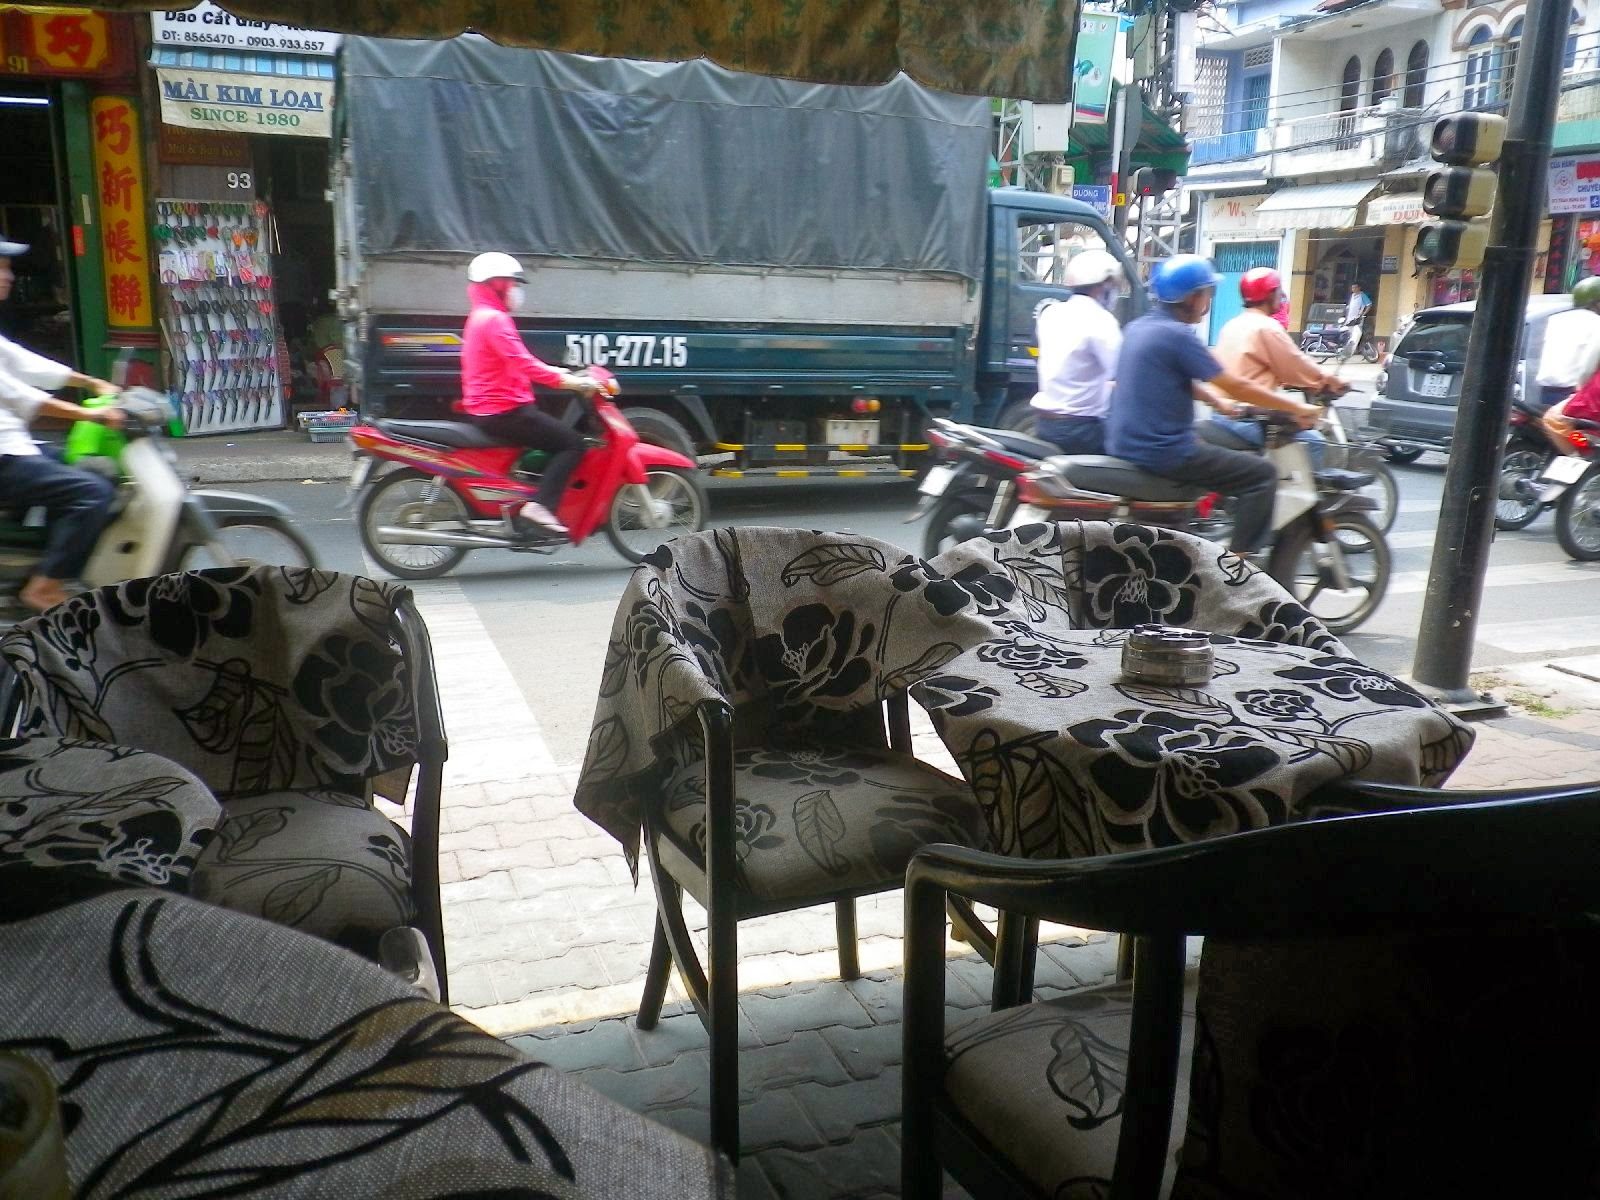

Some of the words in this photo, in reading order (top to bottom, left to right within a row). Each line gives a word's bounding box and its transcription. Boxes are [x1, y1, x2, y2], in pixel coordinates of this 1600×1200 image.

[164, 10, 197, 23] Dao
[161, 30, 181, 42] ĐT:
[184, 31, 235, 45] 8565470
[247, 36, 325, 51] 0903.933.557
[163, 77, 209, 101] MÀI
[216, 84, 263, 105] KIM
[269, 88, 324, 112] LOẠI
[190, 107, 249, 123] SINCE
[256, 112, 301, 127] 1980
[227, 172, 252, 189] 93
[563, 333, 688, 368] 51C-277.15
